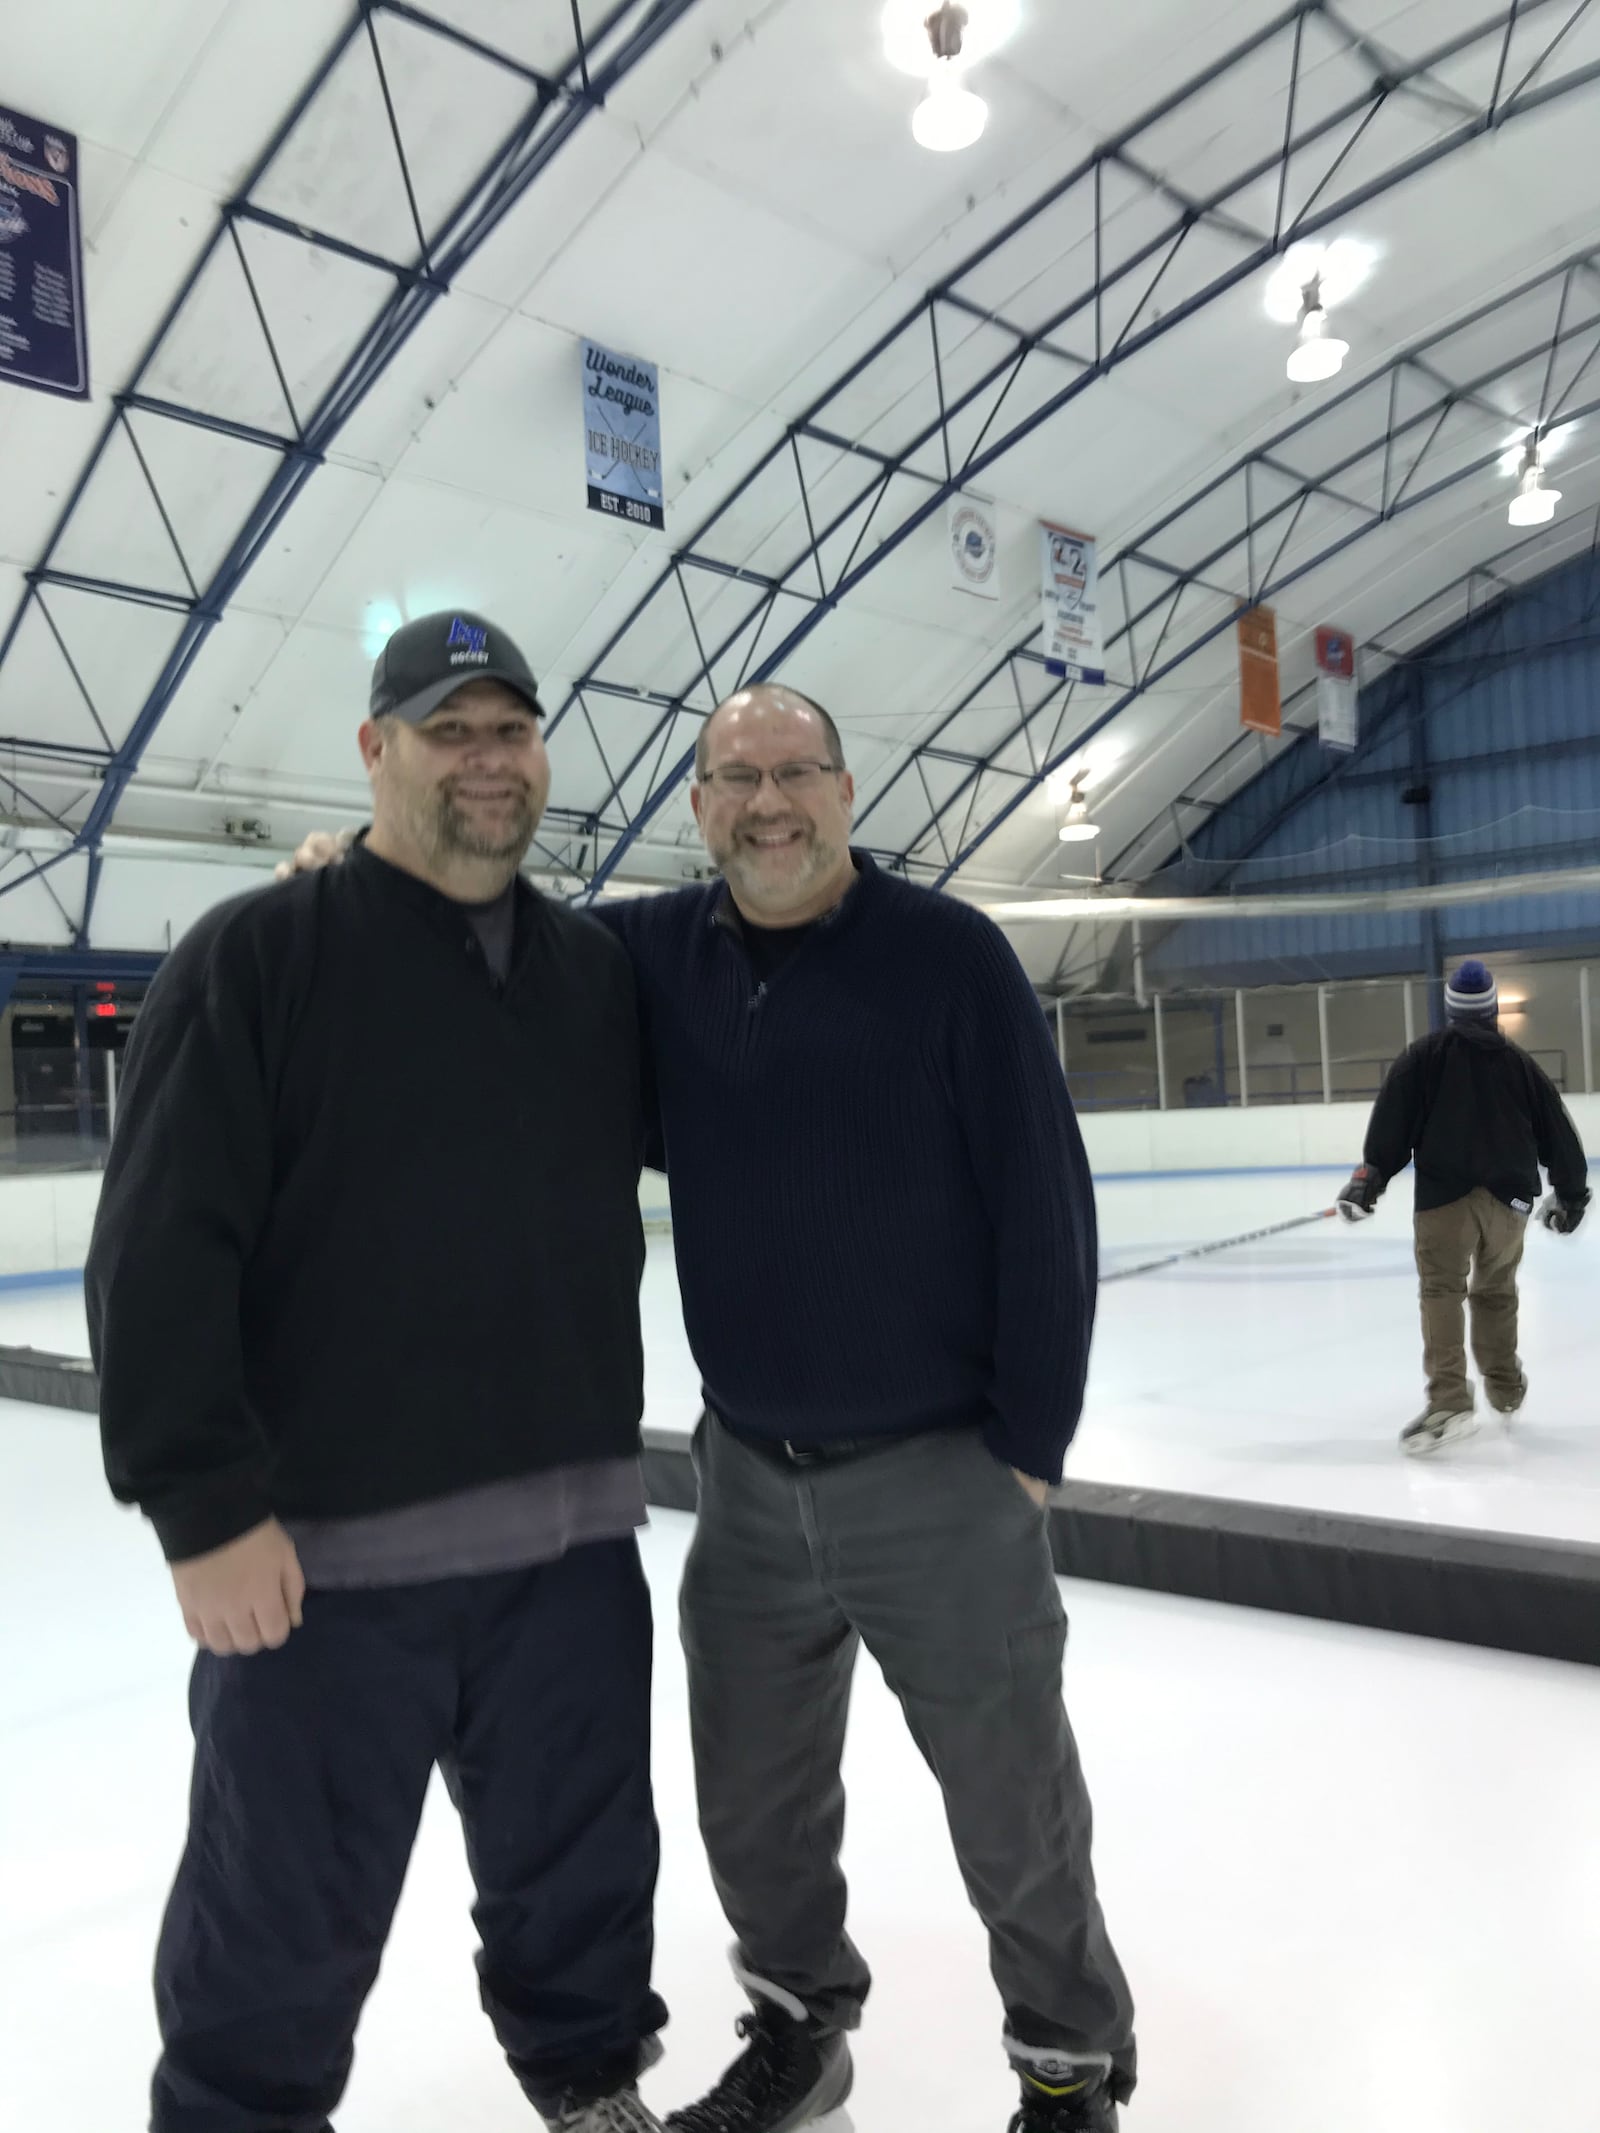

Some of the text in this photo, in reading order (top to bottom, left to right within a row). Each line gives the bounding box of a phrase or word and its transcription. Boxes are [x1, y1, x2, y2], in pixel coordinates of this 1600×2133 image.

[586, 347, 655, 394] Wonder
[588, 375, 655, 416] League
[588, 429, 659, 473] ICE HOCKEY
[625, 500, 652, 523] 2010
[450, 650, 489, 666] HOCKEY
